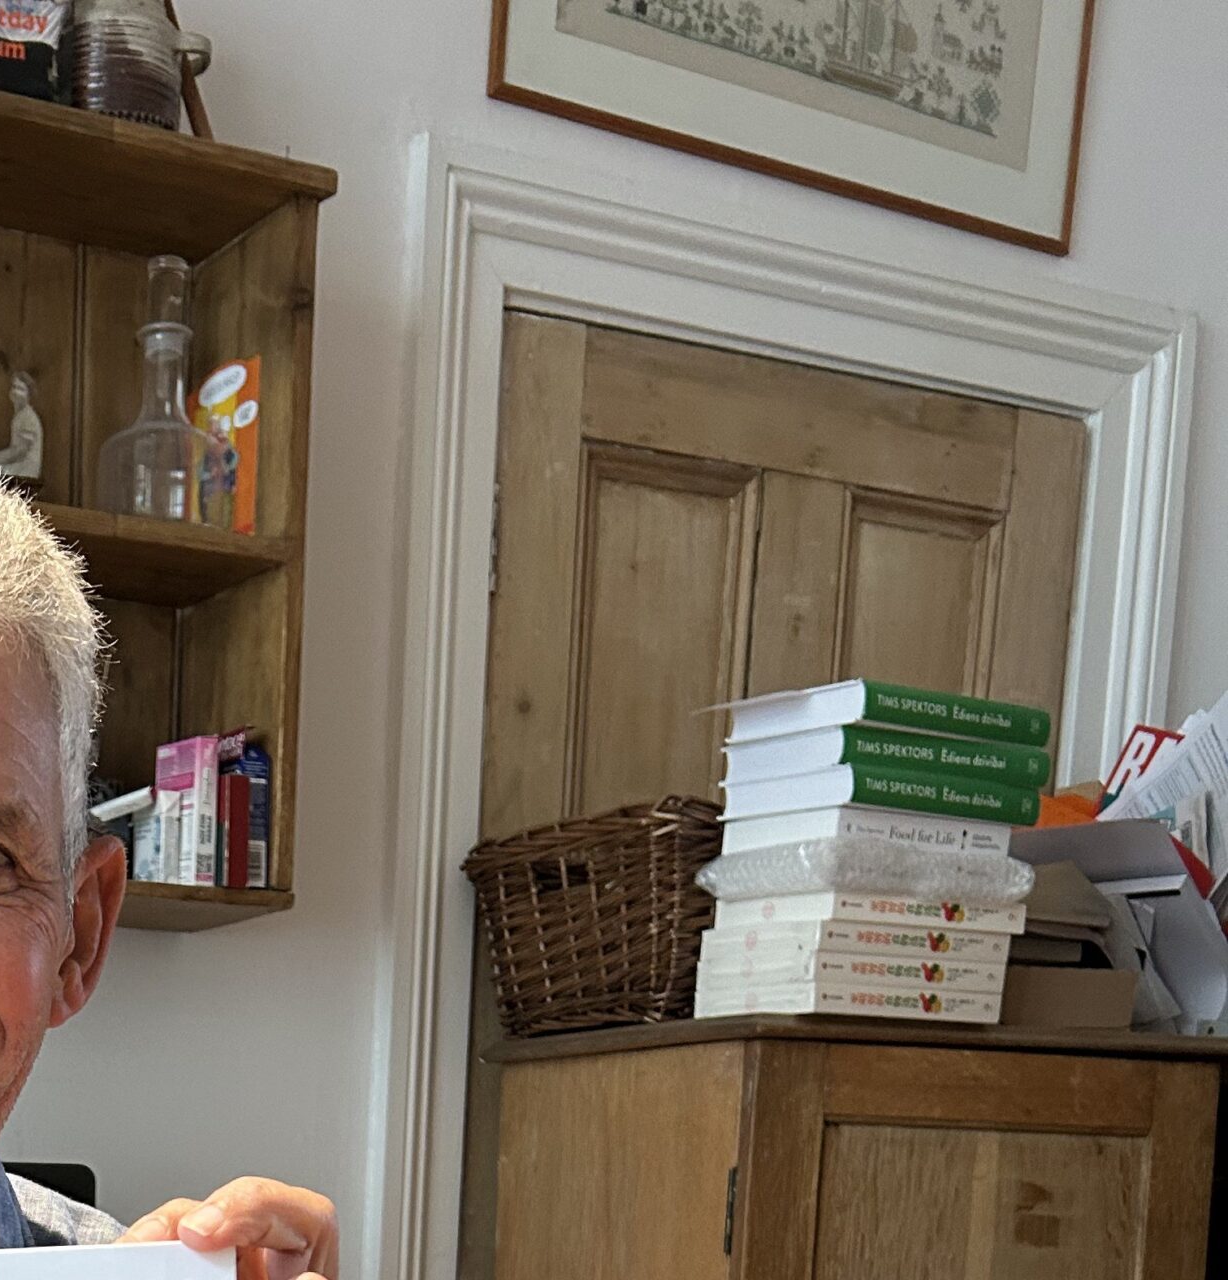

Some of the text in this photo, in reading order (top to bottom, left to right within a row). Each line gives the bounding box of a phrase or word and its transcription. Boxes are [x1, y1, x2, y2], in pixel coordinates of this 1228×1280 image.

[877, 694, 899, 709] TIMS
[901, 698, 948, 717] SPEKTORS
[857, 740, 880, 754] TIMS
[883, 744, 933, 760] SPEKTORS
[866, 778, 887, 792] TIMS
[890, 781, 936, 799] SPEKTORS
[889, 825, 915, 841] Food
[918, 831, 933, 844] for
[935, 831, 956, 845] Life
